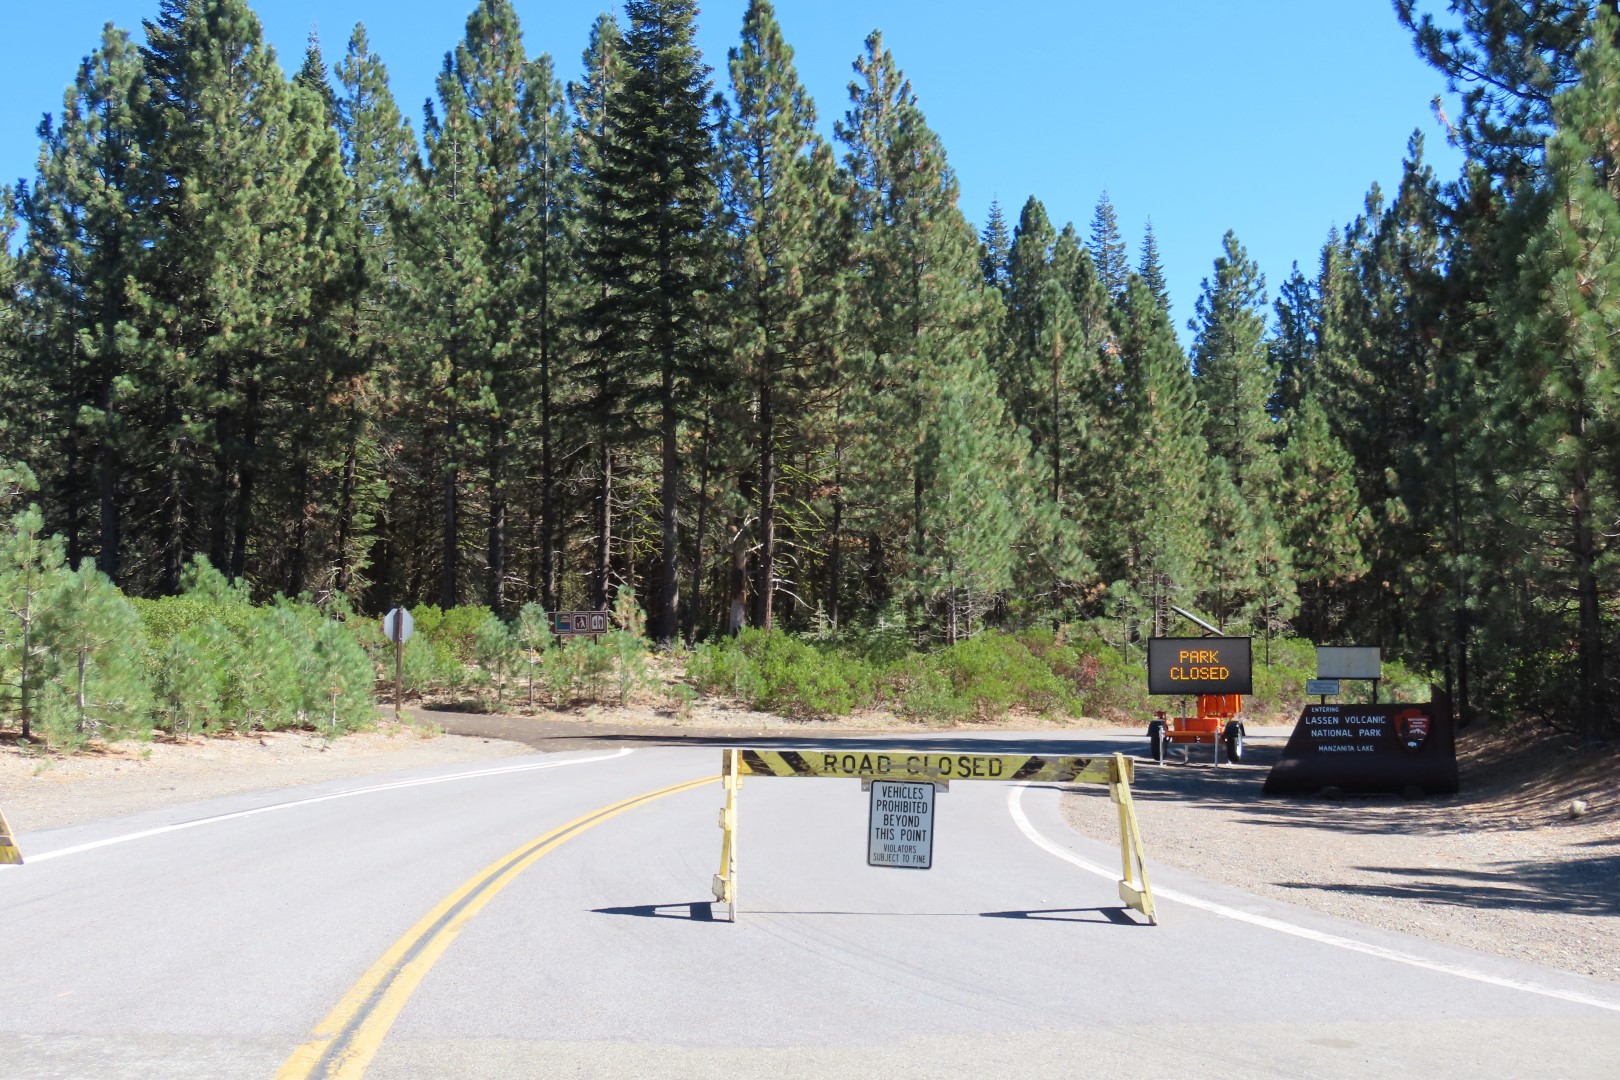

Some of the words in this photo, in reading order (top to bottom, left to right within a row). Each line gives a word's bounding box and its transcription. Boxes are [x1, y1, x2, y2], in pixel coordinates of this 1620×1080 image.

[1179, 650, 1219, 664] PARK
[1170, 666, 1230, 680] CLOSED
[1305, 716, 1339, 725] LASSEN
[1344, 715, 1386, 724] VOLCANIC
[1311, 729, 1353, 737] NATIONAL
[1358, 728, 1381, 737] PARK
[1318, 744, 1355, 752] MANZANITA
[823, 754, 891, 775] ROAD
[907, 756, 1004, 779] CLOSED
[882, 785, 924, 800] VEHICLES
[876, 799, 928, 814] PROHIBITED
[883, 813, 920, 828] BEYOND
[875, 827, 895, 841] THIS
[900, 828, 927, 842] POINT
[883, 843, 917, 854] VIOLATORS
[873, 852, 899, 863] SUBJECT
[902, 854, 910, 863] TO
[912, 854, 926, 864] FINE
